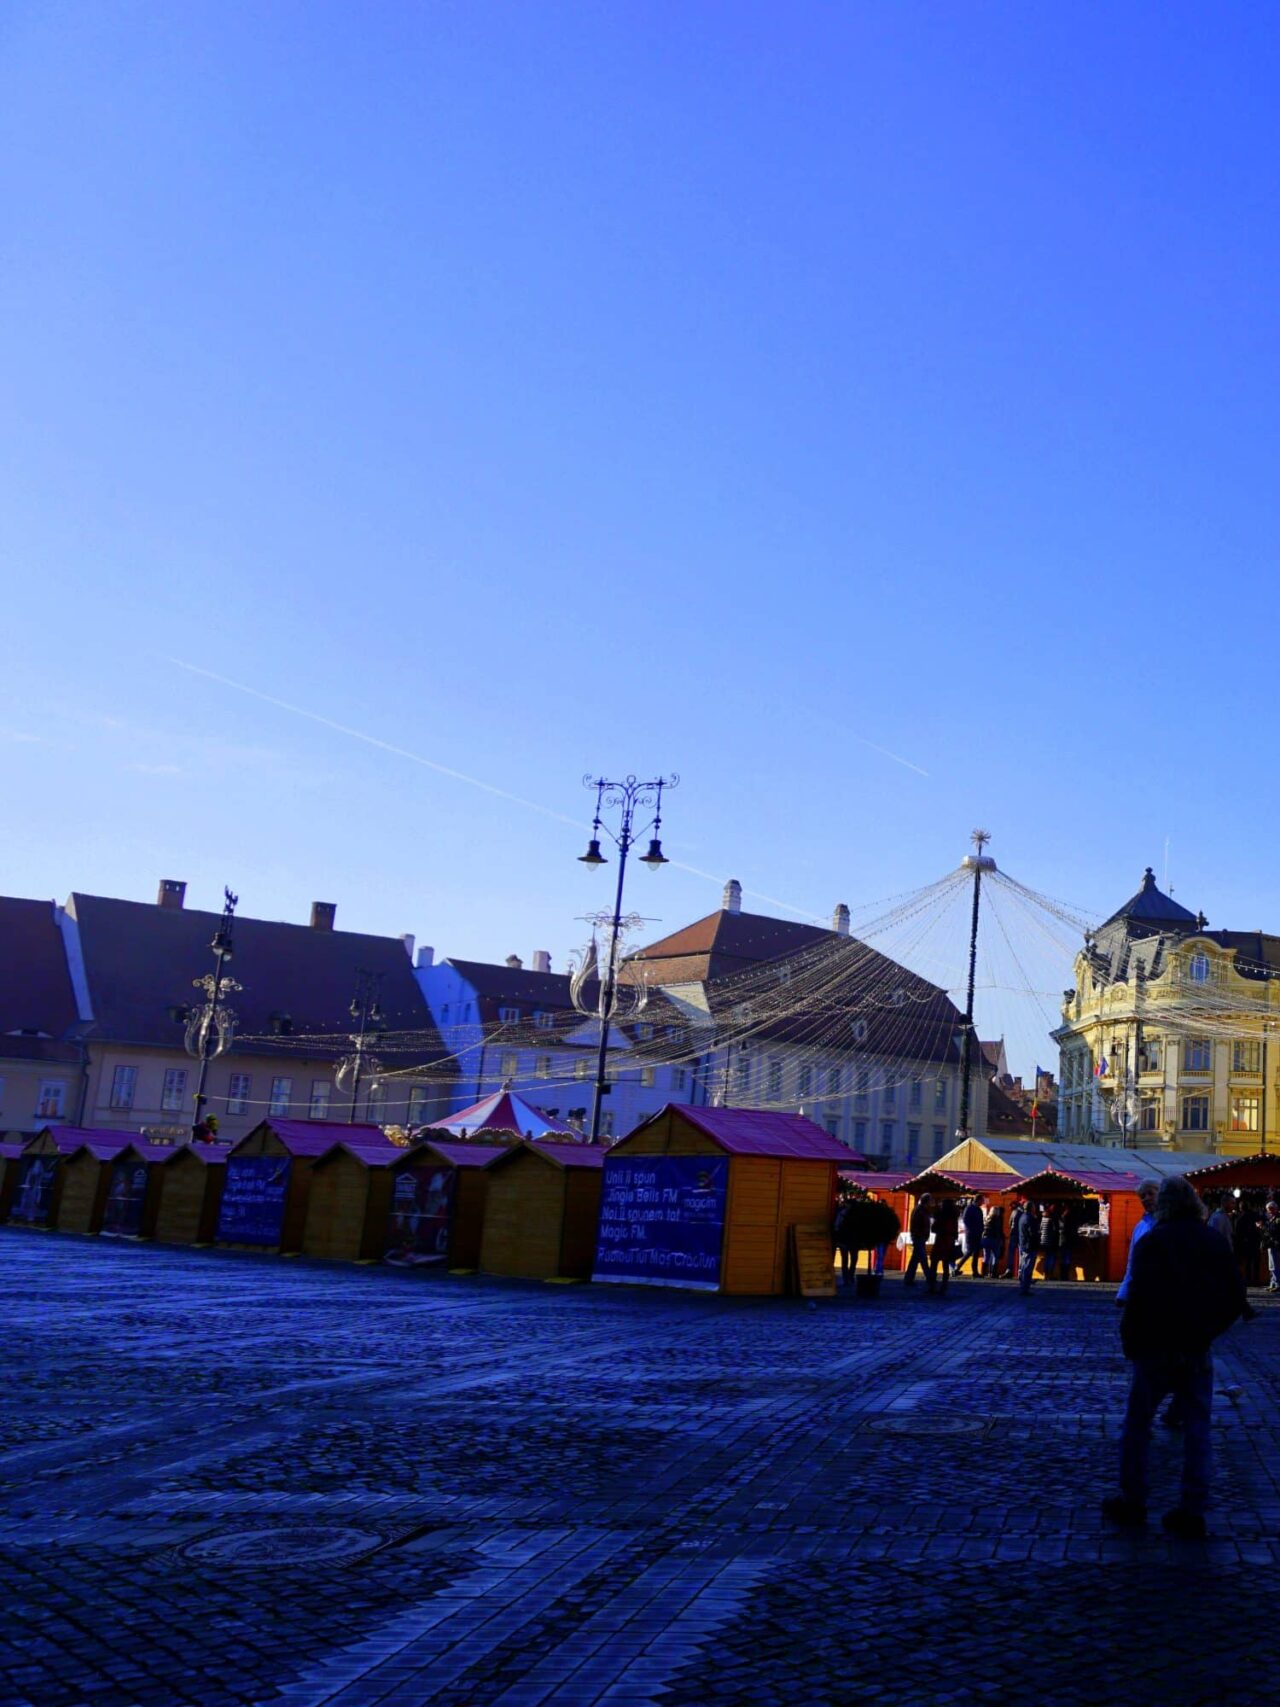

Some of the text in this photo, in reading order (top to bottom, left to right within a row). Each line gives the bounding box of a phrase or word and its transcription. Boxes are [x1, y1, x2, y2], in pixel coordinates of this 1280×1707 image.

[633, 1172, 656, 1187] spun
[607, 1188, 679, 1205] Jingle Bells FM
[627, 1208, 664, 1222] spunem
[666, 1207, 681, 1222] tot
[600, 1223, 628, 1242] Magic
